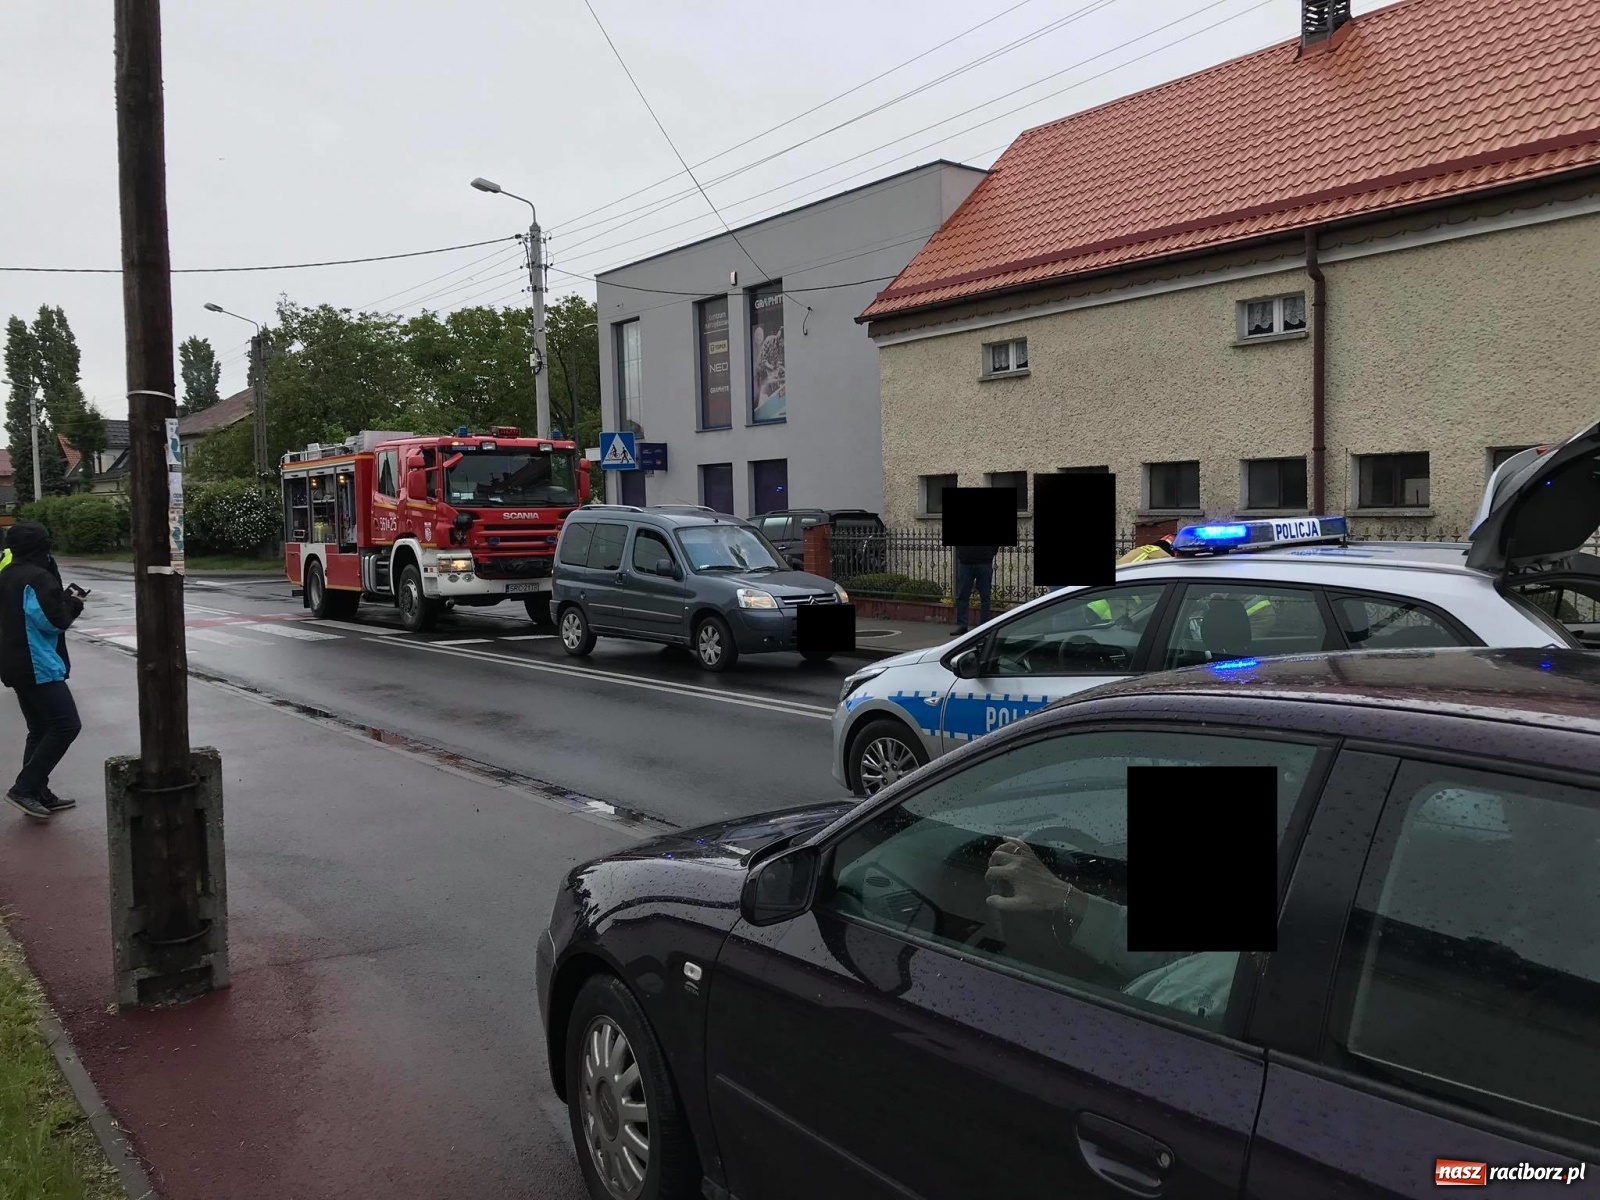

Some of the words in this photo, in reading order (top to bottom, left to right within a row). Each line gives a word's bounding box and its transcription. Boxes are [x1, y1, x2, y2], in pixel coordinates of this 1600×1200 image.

[709, 361, 728, 373] NEO
[502, 511, 540, 520] SCANIA
[1275, 521, 1319, 540] POLICJA
